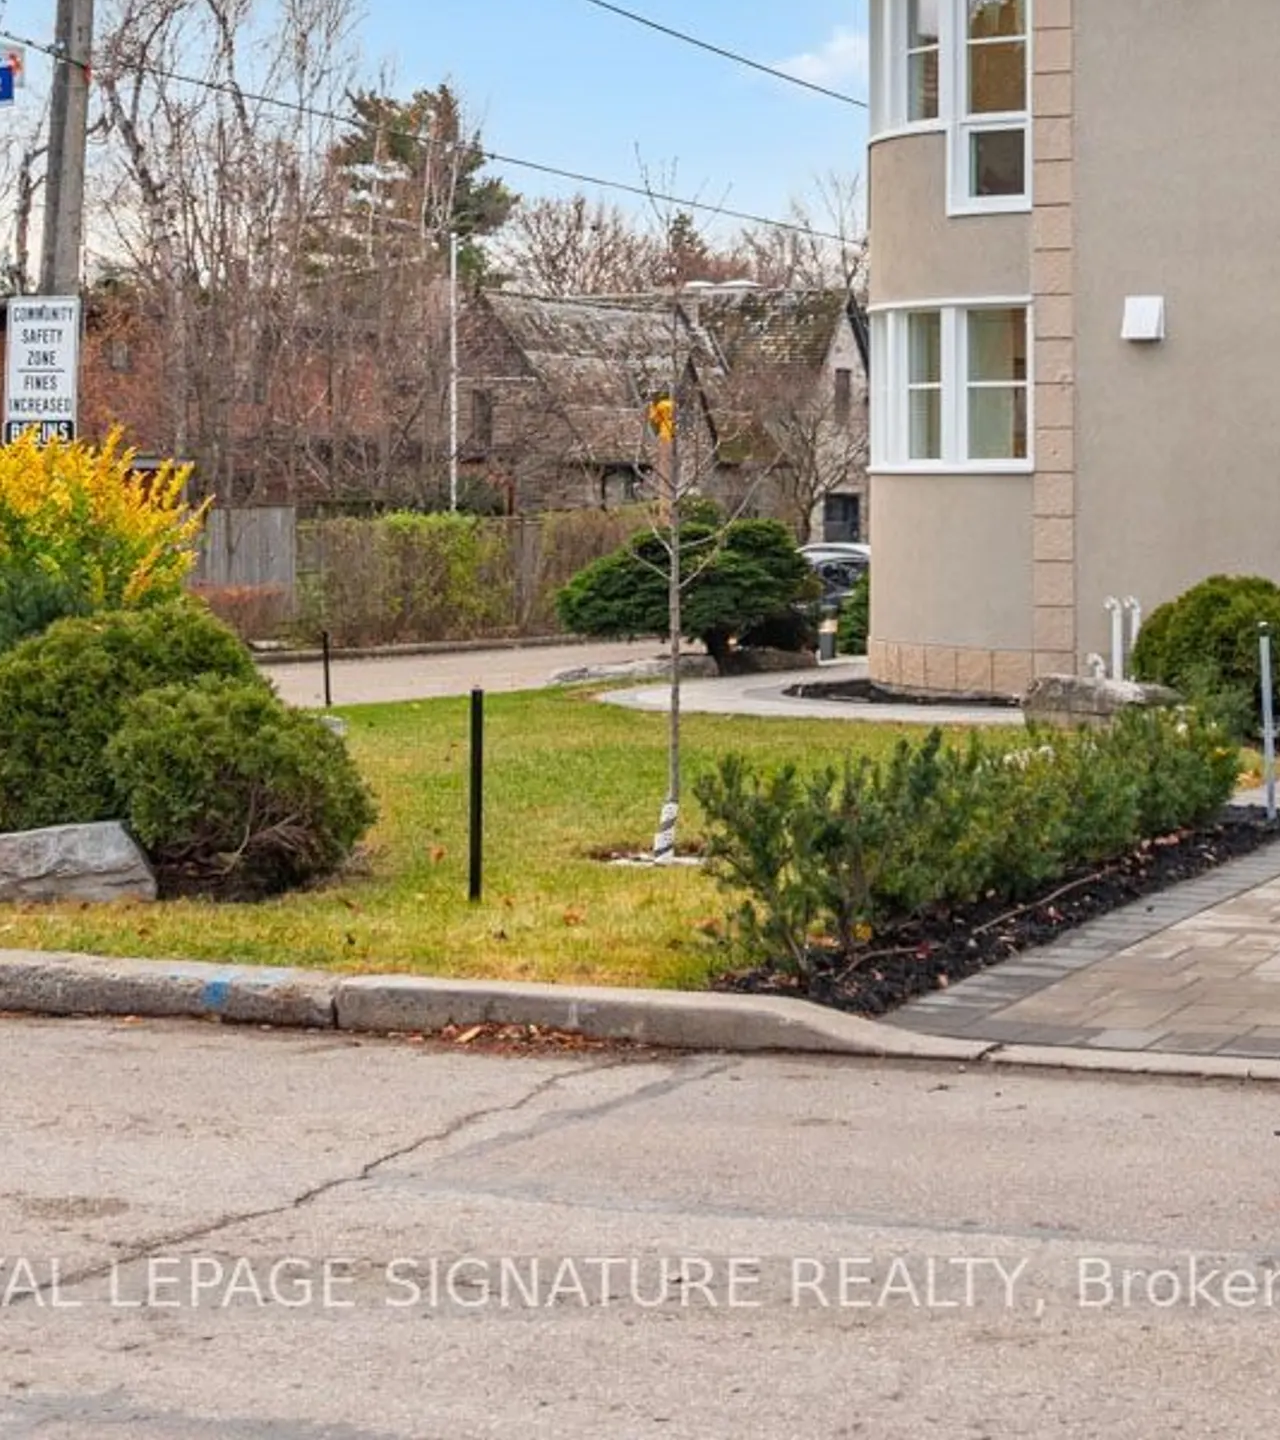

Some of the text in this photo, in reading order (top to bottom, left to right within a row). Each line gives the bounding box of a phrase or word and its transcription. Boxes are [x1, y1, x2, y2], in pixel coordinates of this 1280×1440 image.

[13, 307, 73, 322] COMMUNITY
[21, 328, 63, 344] SAFETY
[27, 350, 57, 366] ZONE
[23, 374, 59, 391] FINES
[9, 398, 73, 413] INCREASED
[11, 422, 69, 443] BINS
